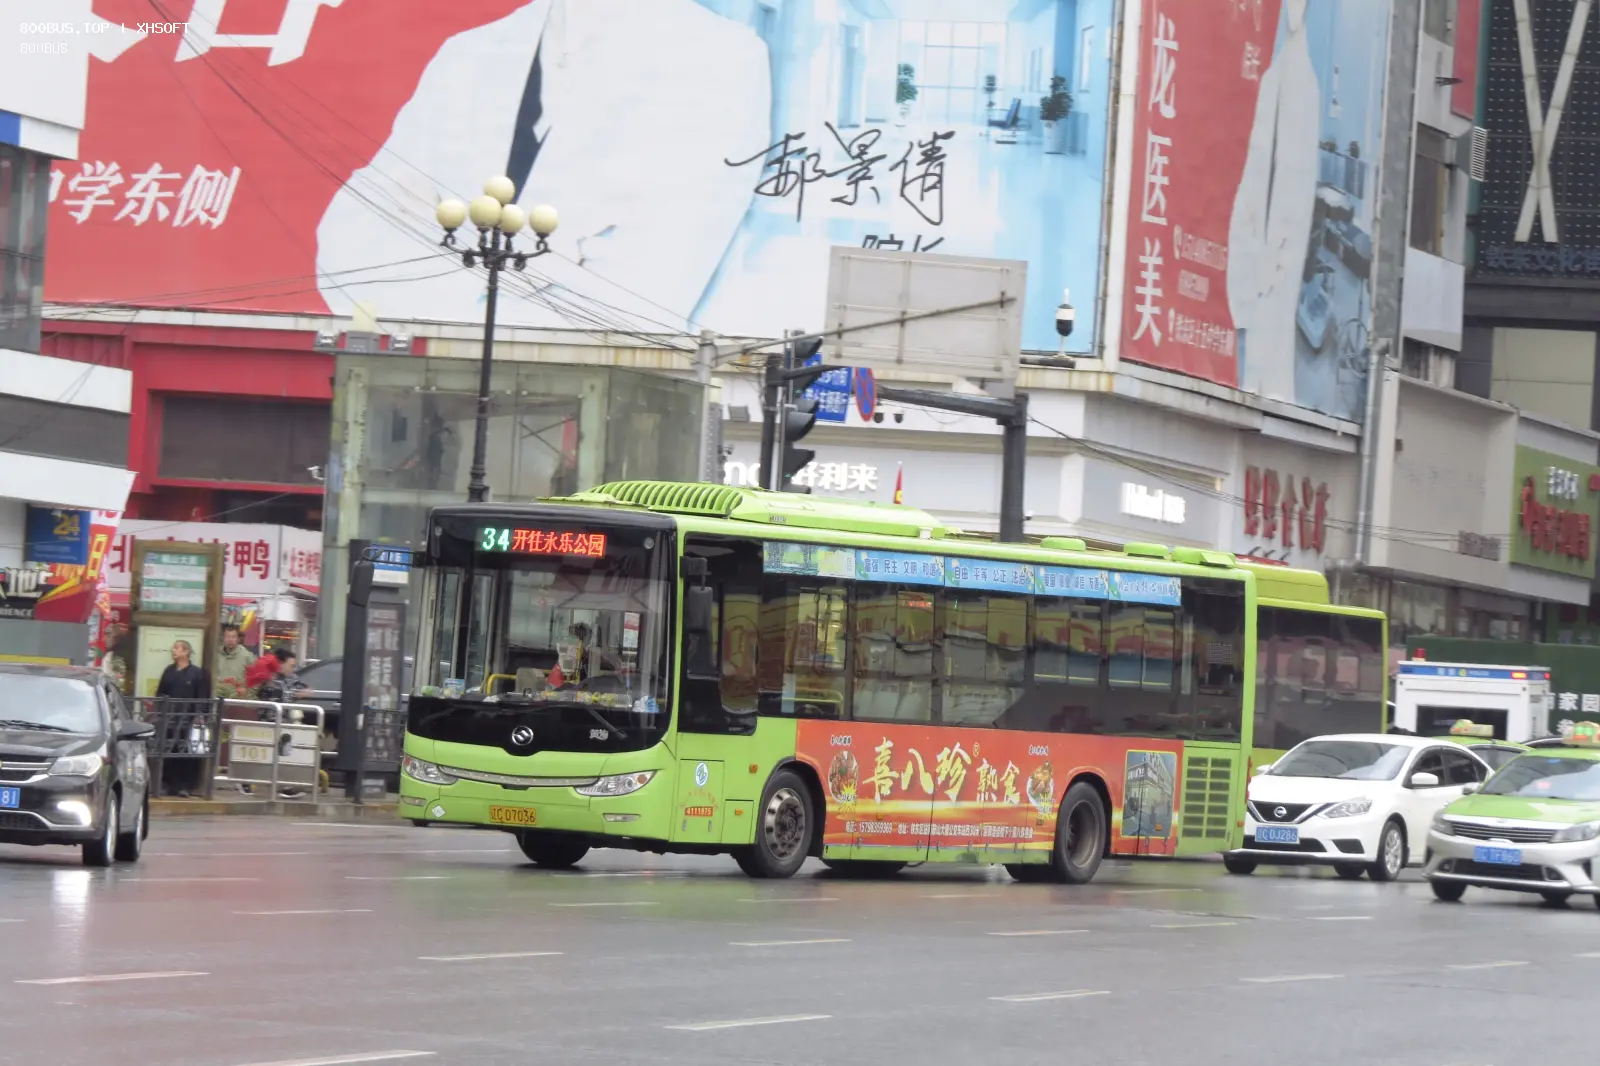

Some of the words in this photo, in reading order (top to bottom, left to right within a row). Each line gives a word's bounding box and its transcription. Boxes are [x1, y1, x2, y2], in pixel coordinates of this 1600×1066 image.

[482, 527, 510, 551] 34
[511, 529, 605, 557] 开往永乐公园
[110, 534, 270, 580] 北鸭
[884, 559, 898, 574] 民主
[953, 566, 969, 580] 自由
[973, 567, 988, 581] 平等
[993, 568, 1007, 584] 公正
[240, 746, 268, 761] 101
